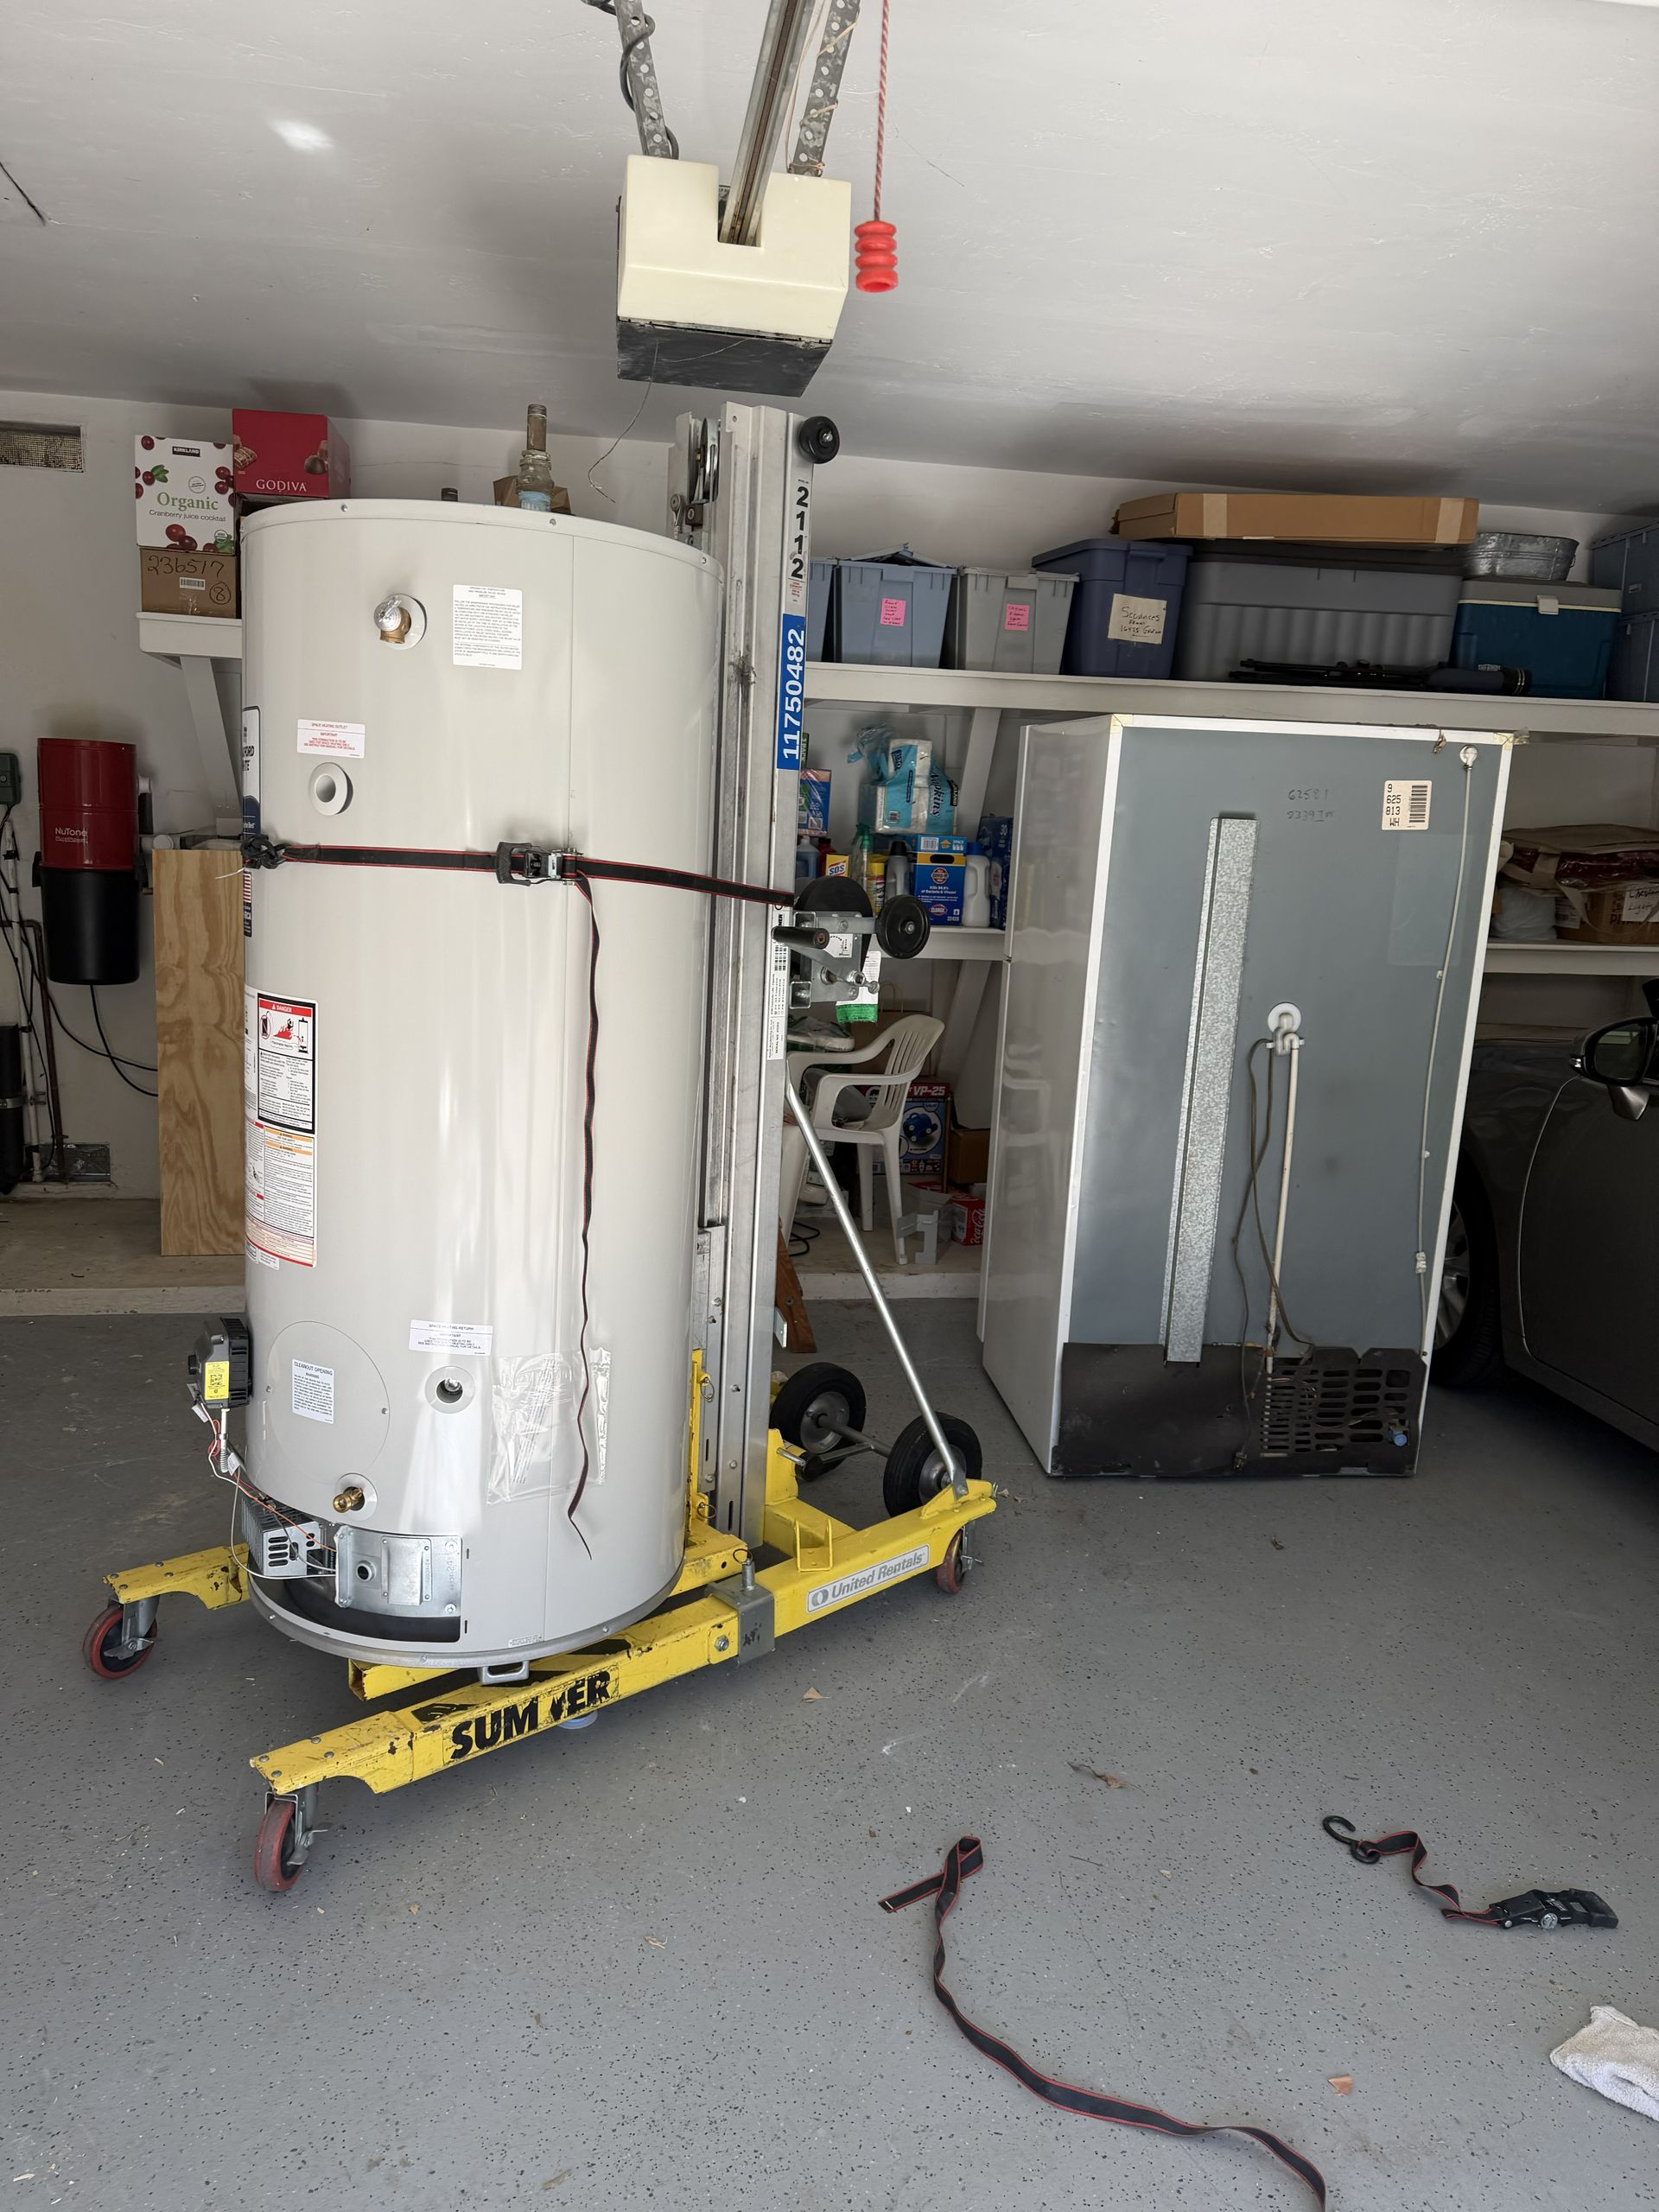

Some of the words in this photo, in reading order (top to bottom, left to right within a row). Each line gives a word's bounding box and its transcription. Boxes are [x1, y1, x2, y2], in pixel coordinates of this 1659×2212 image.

[256, 479, 307, 492] GODIVA
[156, 492, 219, 512] Organic
[149, 509, 182, 518] Cranberry
[183, 512, 200, 520] juice
[791, 486, 809, 579] 2112
[783, 628, 804, 760] 11750482
[1387, 784, 1393, 792] 9
[931, 772, 944, 817] Napkins
[1386, 795, 1401, 804] 625
[1385, 806, 1401, 816] 813
[1389, 817, 1400, 827] WH
[55, 827, 87, 836] NuTone
[913, 1085, 945, 1096] VP-25
[294, 1361, 314, 1370] CLEANOUT
[315, 1367, 333, 1376] OPENING
[831, 1573, 875, 1599] United
[877, 1552, 923, 1580] Rentals
